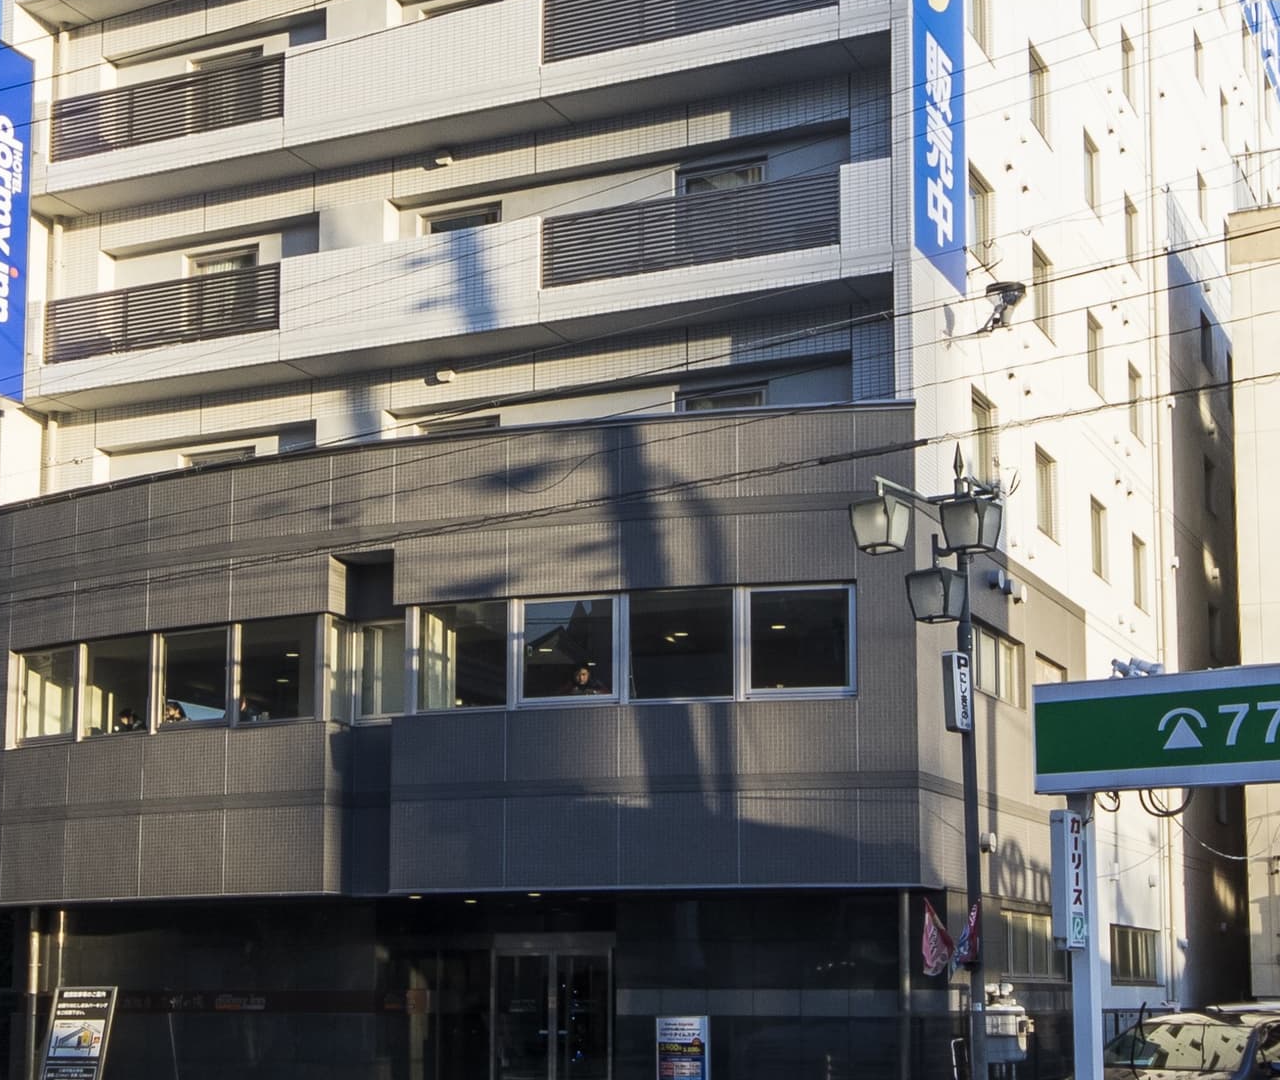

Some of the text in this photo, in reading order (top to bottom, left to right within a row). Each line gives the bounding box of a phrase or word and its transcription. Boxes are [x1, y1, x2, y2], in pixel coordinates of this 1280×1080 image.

[1070, 817, 1083, 905] カーリース
